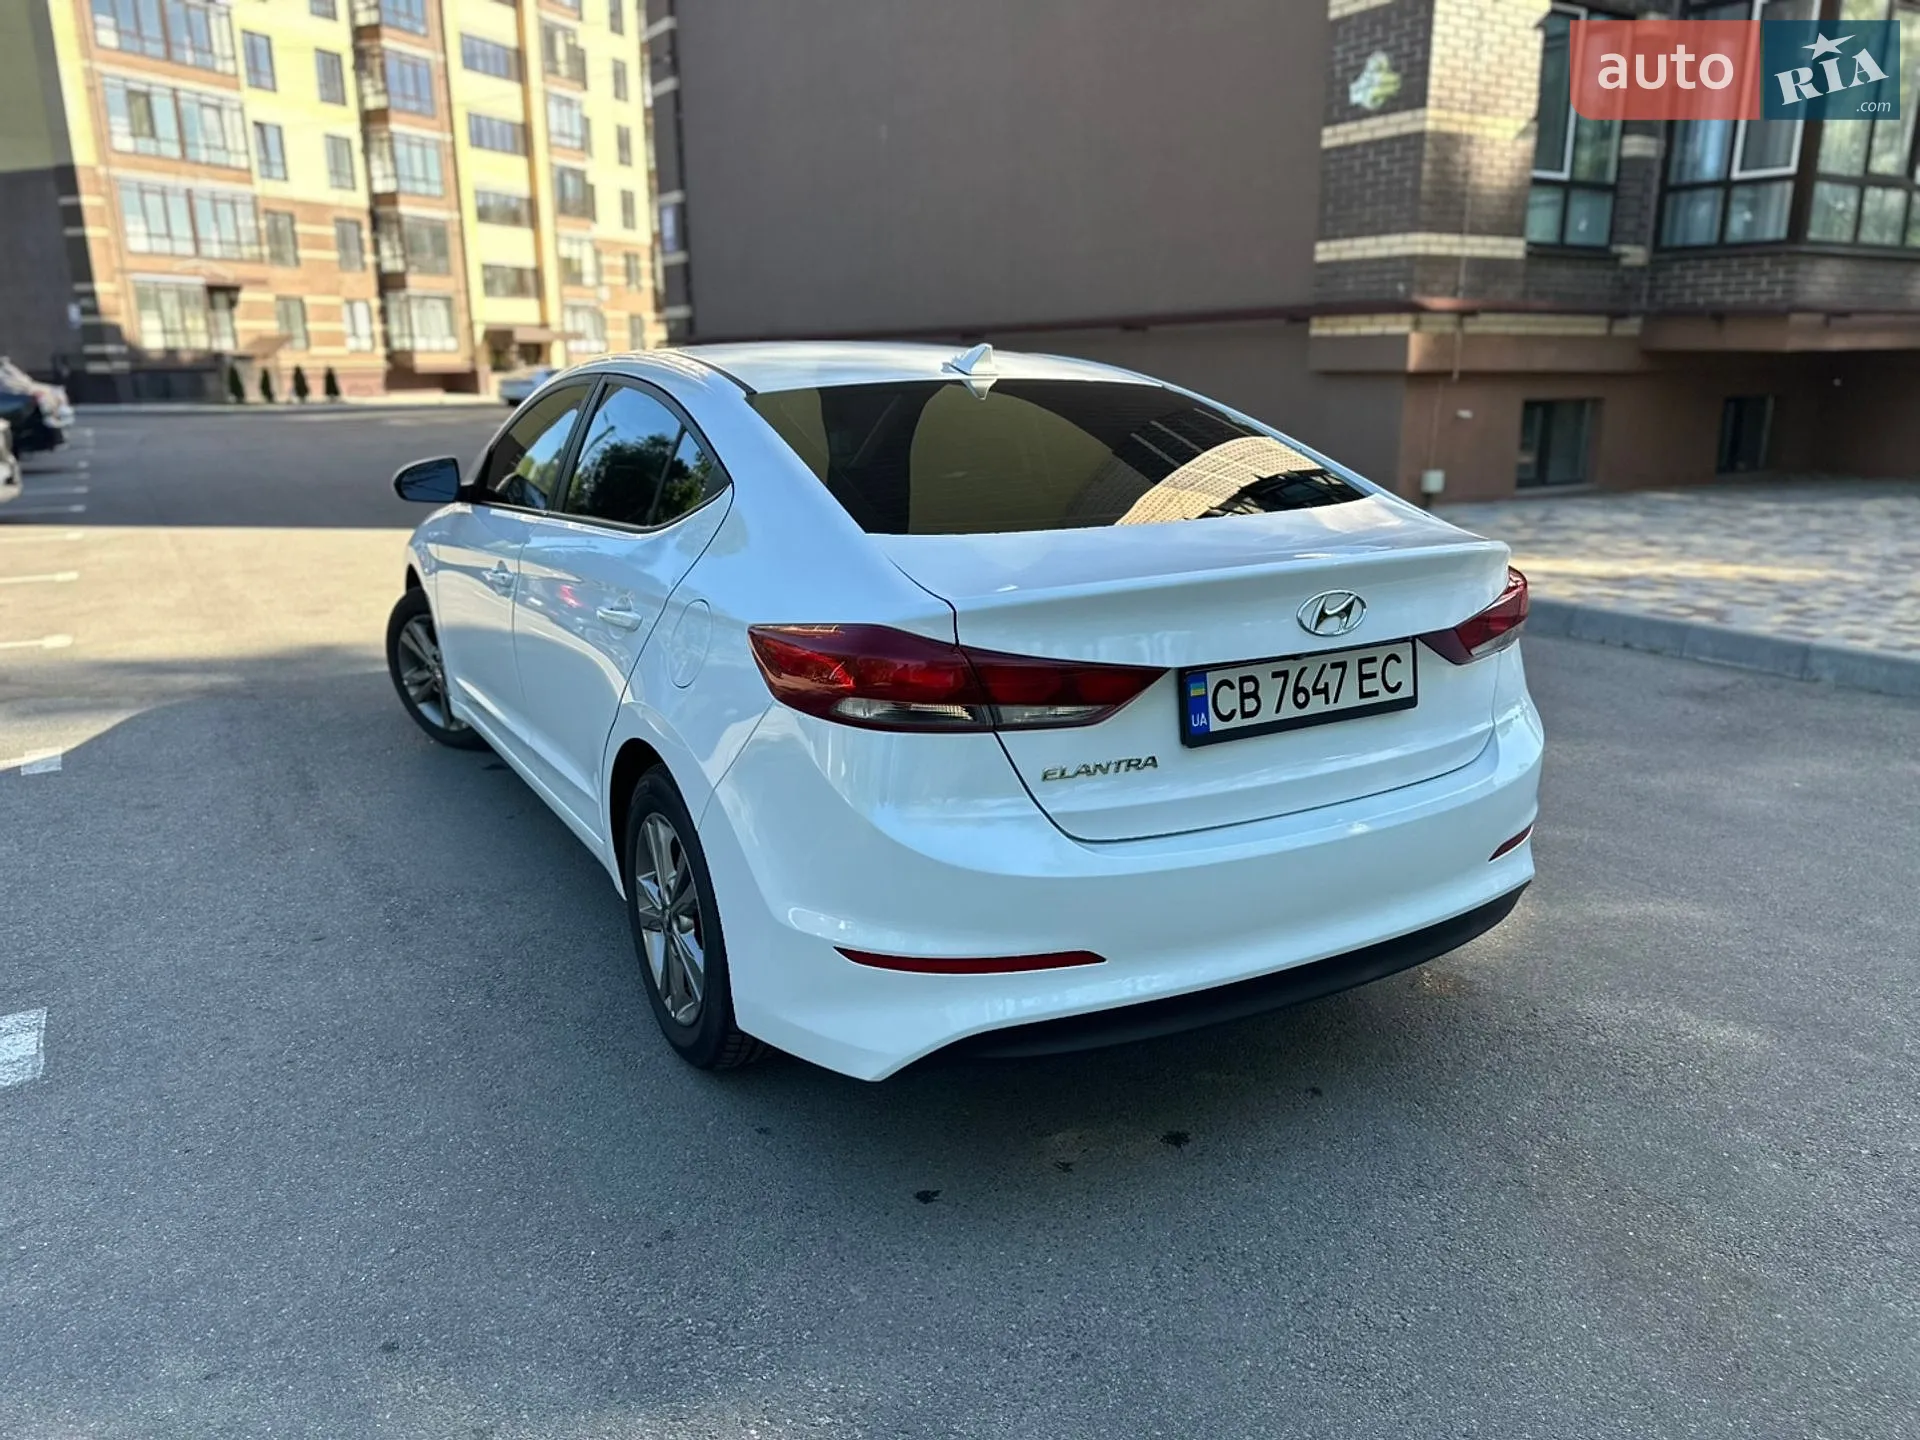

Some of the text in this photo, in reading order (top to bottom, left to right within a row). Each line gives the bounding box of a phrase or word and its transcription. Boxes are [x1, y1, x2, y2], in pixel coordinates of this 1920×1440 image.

[1211, 653, 1403, 722] CB 7647 EC
[1191, 713, 1208, 727] UA
[1041, 755, 1158, 782] ELANTRA
